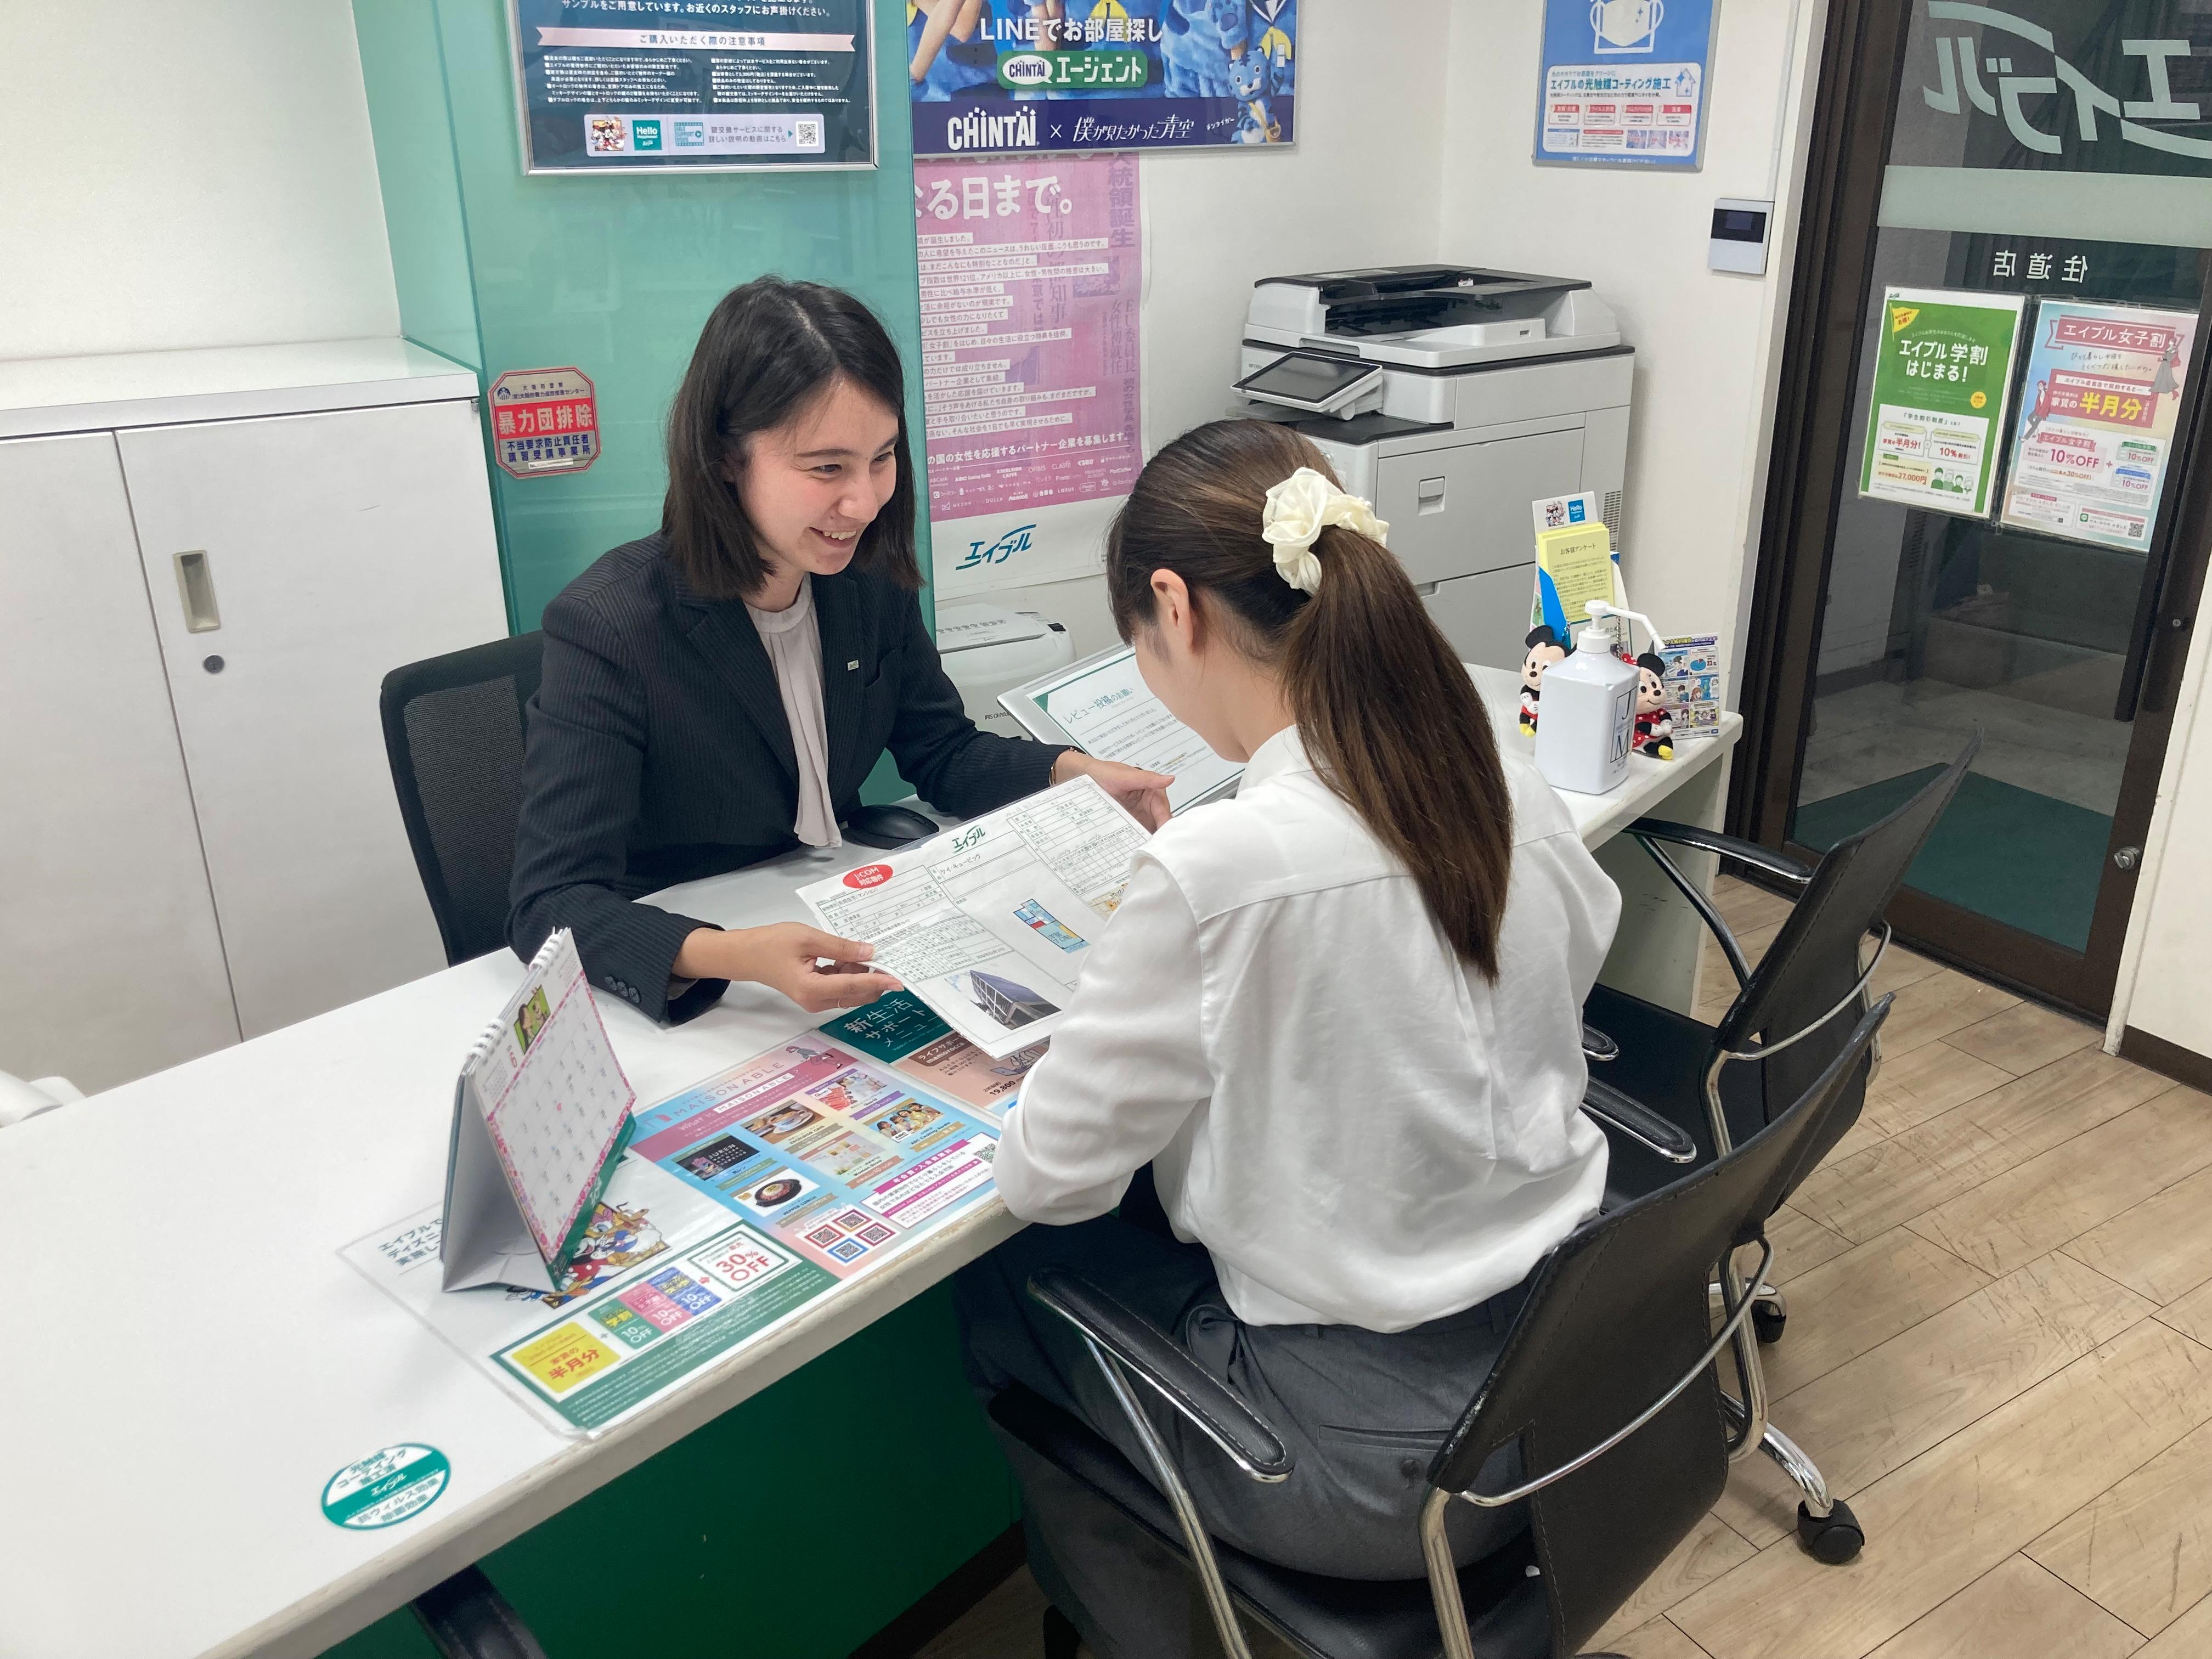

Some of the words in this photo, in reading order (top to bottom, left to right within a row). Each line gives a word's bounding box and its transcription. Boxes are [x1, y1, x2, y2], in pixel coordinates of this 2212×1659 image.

[640, 35, 766, 47] ご購入いただく際の注意事項
[980, 17, 1163, 42] LINEでお部屋探し
[1008, 61, 1046, 78] CHINTAI
[1057, 56, 1142, 84] エージェント
[947, 106, 1037, 150] CHINTAI
[1073, 114, 1194, 142] 僕が見たかった青空
[2063, 324, 2167, 349] エイブル女子割
[923, 354, 952, 363] ています。
[1899, 340, 1989, 365] エイブル学割
[1906, 360, 1968, 382] はじまる!
[925, 386, 1021, 400] を活かした応援を届けていきます。
[2051, 397, 2078, 409] 家賃の
[2079, 392, 2142, 421] 半月分
[498, 403, 593, 435] 暴力団排除
[507, 434, 589, 451] 不当要求防止責任者
[2051, 448, 2100, 468] 10%OFF
[956, 524, 1036, 570] エイブル
[1560, 543, 1596, 555] お客様アンケート
[1063, 687, 1134, 724] レビュー投稿のお願い
[952, 825, 986, 854] エイブル
[854, 867, 880, 881] J:COM
[940, 854, 981, 875] ケイ・キュービック
[858, 873, 884, 887] 対応物件
[844, 997, 914, 1033] 新生活
[865, 1008, 926, 1040] サポート
[674, 1083, 738, 1116] MAISON
[742, 1062, 785, 1085] ABLE
[718, 1089, 760, 1111] MAISON
[762, 1075, 791, 1091] ABLE
[989, 1080, 1016, 1096] 19,800
[715, 1251, 759, 1273] 30%
[730, 1255, 770, 1283] OFF
[689, 1295, 713, 1310] OFF
[660, 1311, 683, 1327] OFF
[630, 1328, 653, 1344] OFF
[549, 1348, 601, 1380] 半月分
[337, 1448, 407, 1488] コーティング
[371, 1473, 407, 1497] エイブル
